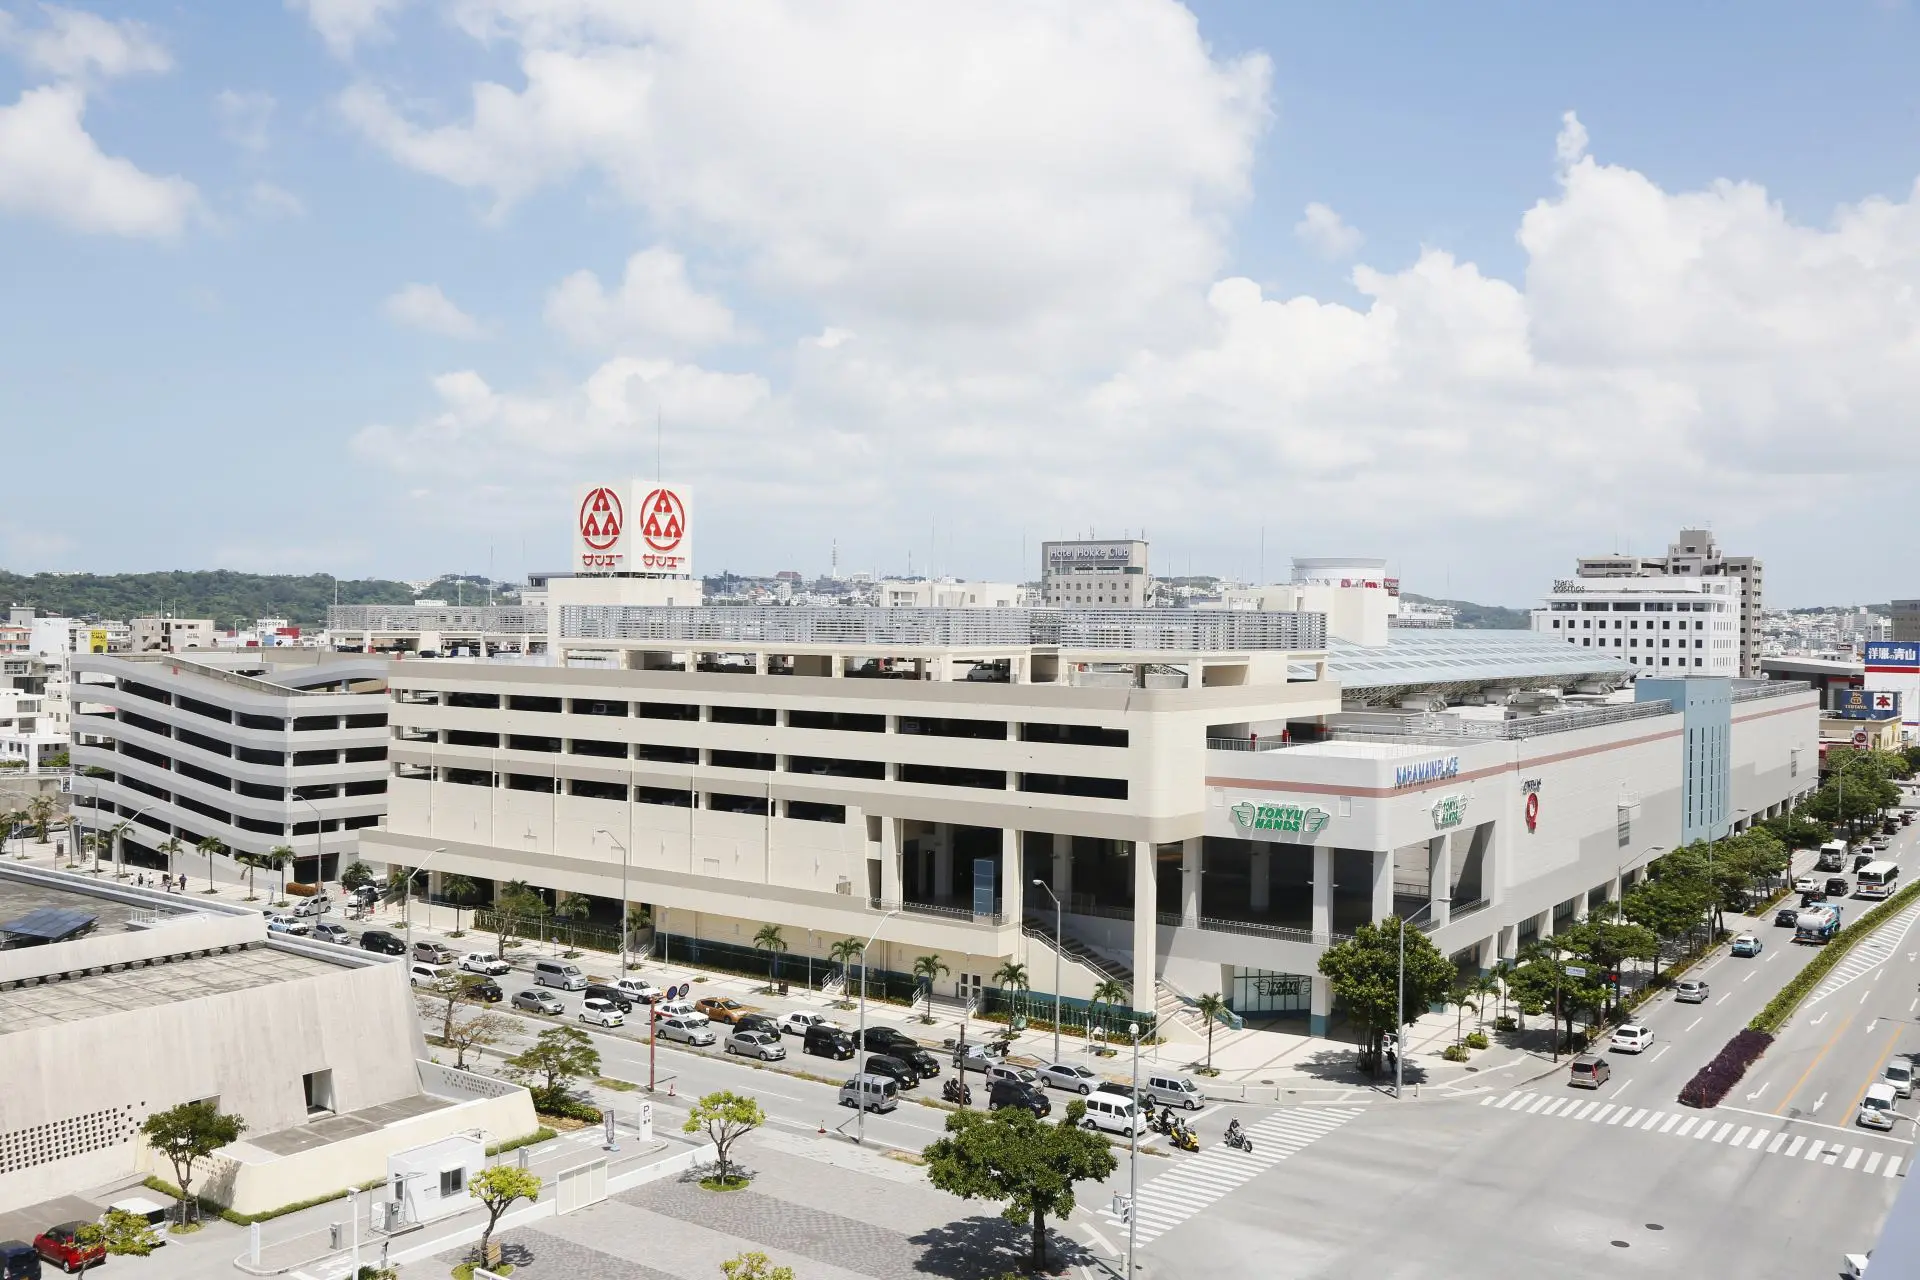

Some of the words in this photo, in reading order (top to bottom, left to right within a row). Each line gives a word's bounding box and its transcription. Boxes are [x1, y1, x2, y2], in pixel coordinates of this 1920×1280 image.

[1050, 549, 1074, 558] Hotel
[1077, 548, 1106, 558] Hokke
[1109, 547, 1129, 557] Club
[582, 553, 623, 567] サンエー
[642, 553, 685, 568] サンエー
[1553, 585, 1585, 593] cosmos
[1868, 647, 1916, 661] 洋服の青山
[1876, 695, 1891, 709] 本
[1258, 806, 1304, 820] TOKYU
[1255, 818, 1301, 832] HANDS
[643, 1105, 650, 1116] P
